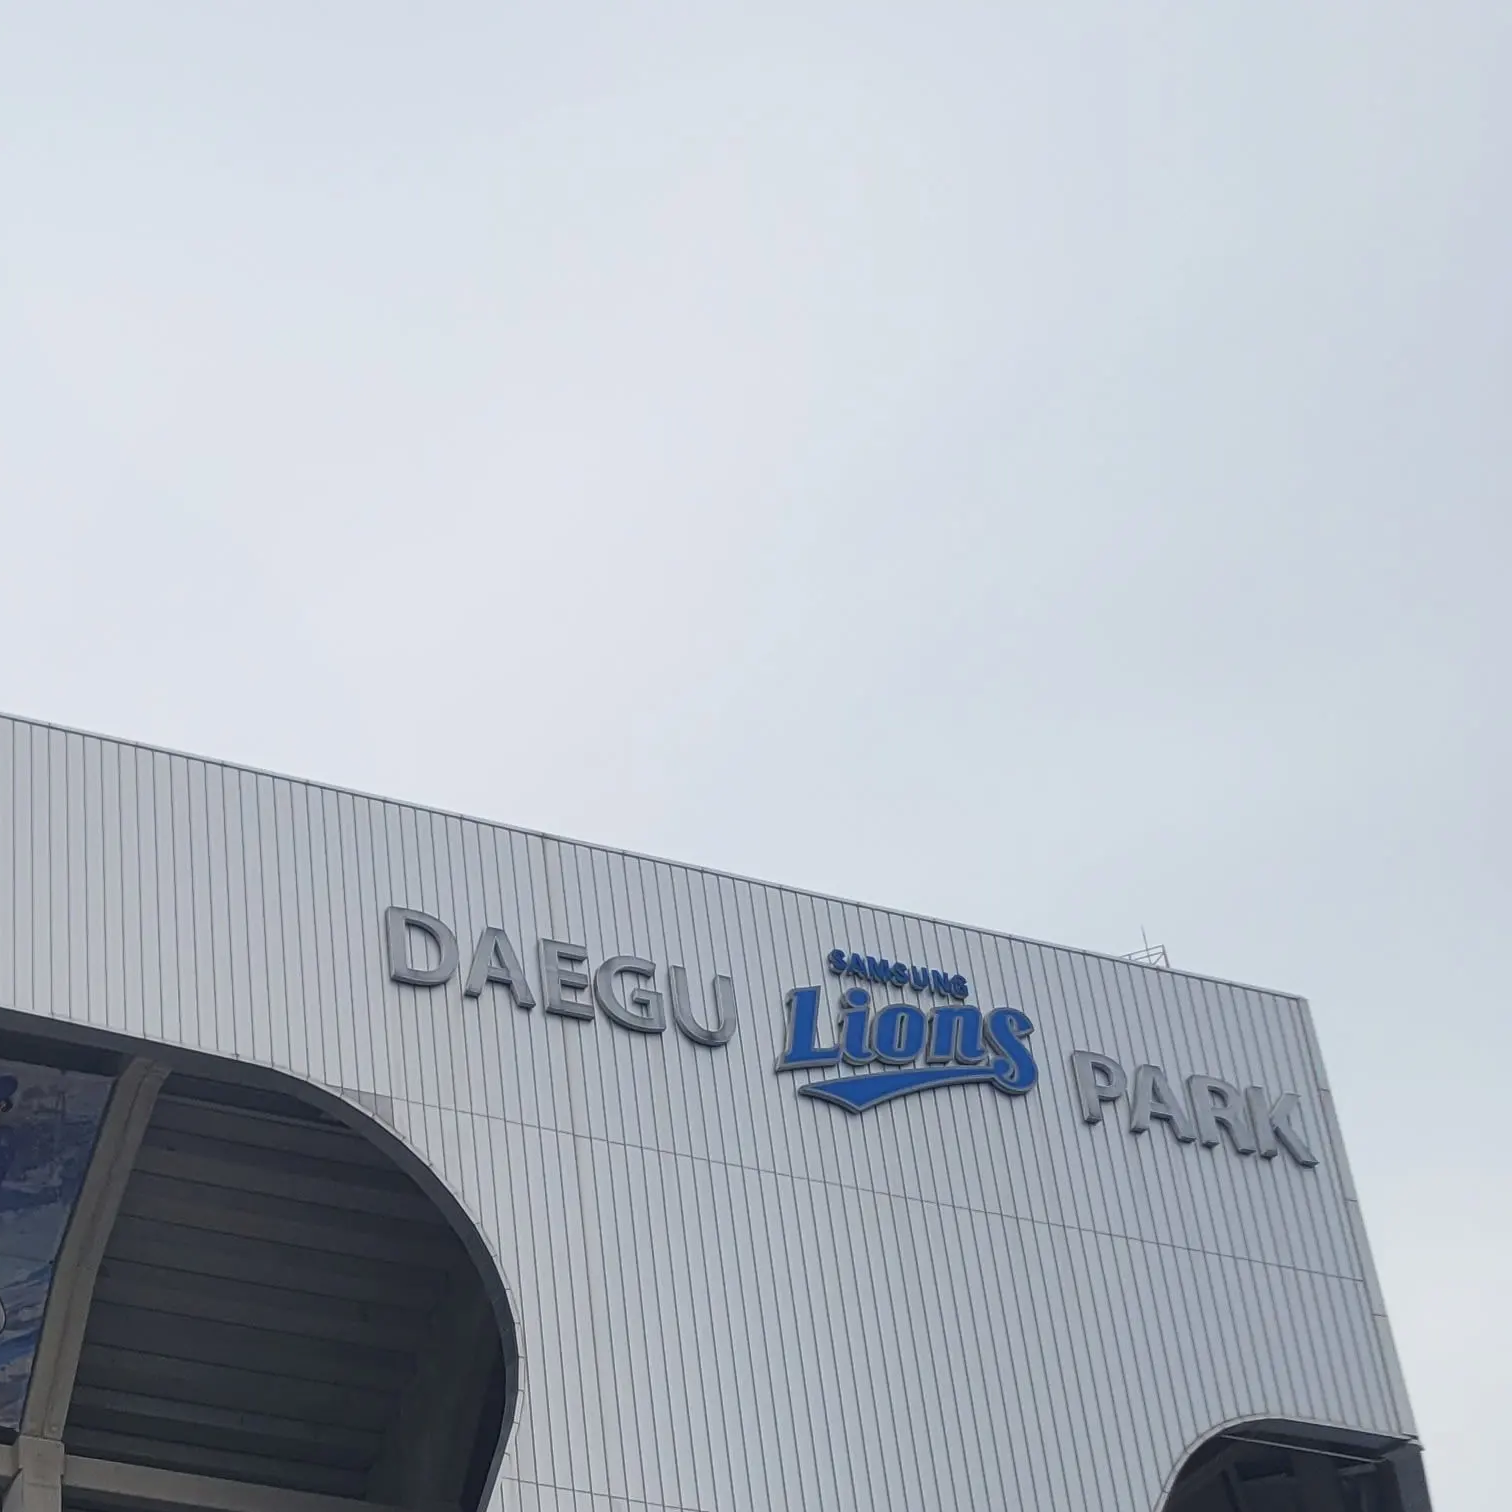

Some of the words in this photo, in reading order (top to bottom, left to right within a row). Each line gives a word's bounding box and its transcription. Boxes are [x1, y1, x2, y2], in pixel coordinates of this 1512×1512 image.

[384, 905, 738, 1049] DAEGU
[826, 947, 970, 998] SAMSUNG
[775, 984, 1037, 1098] Lions
[1070, 1048, 1320, 1168] PARK
